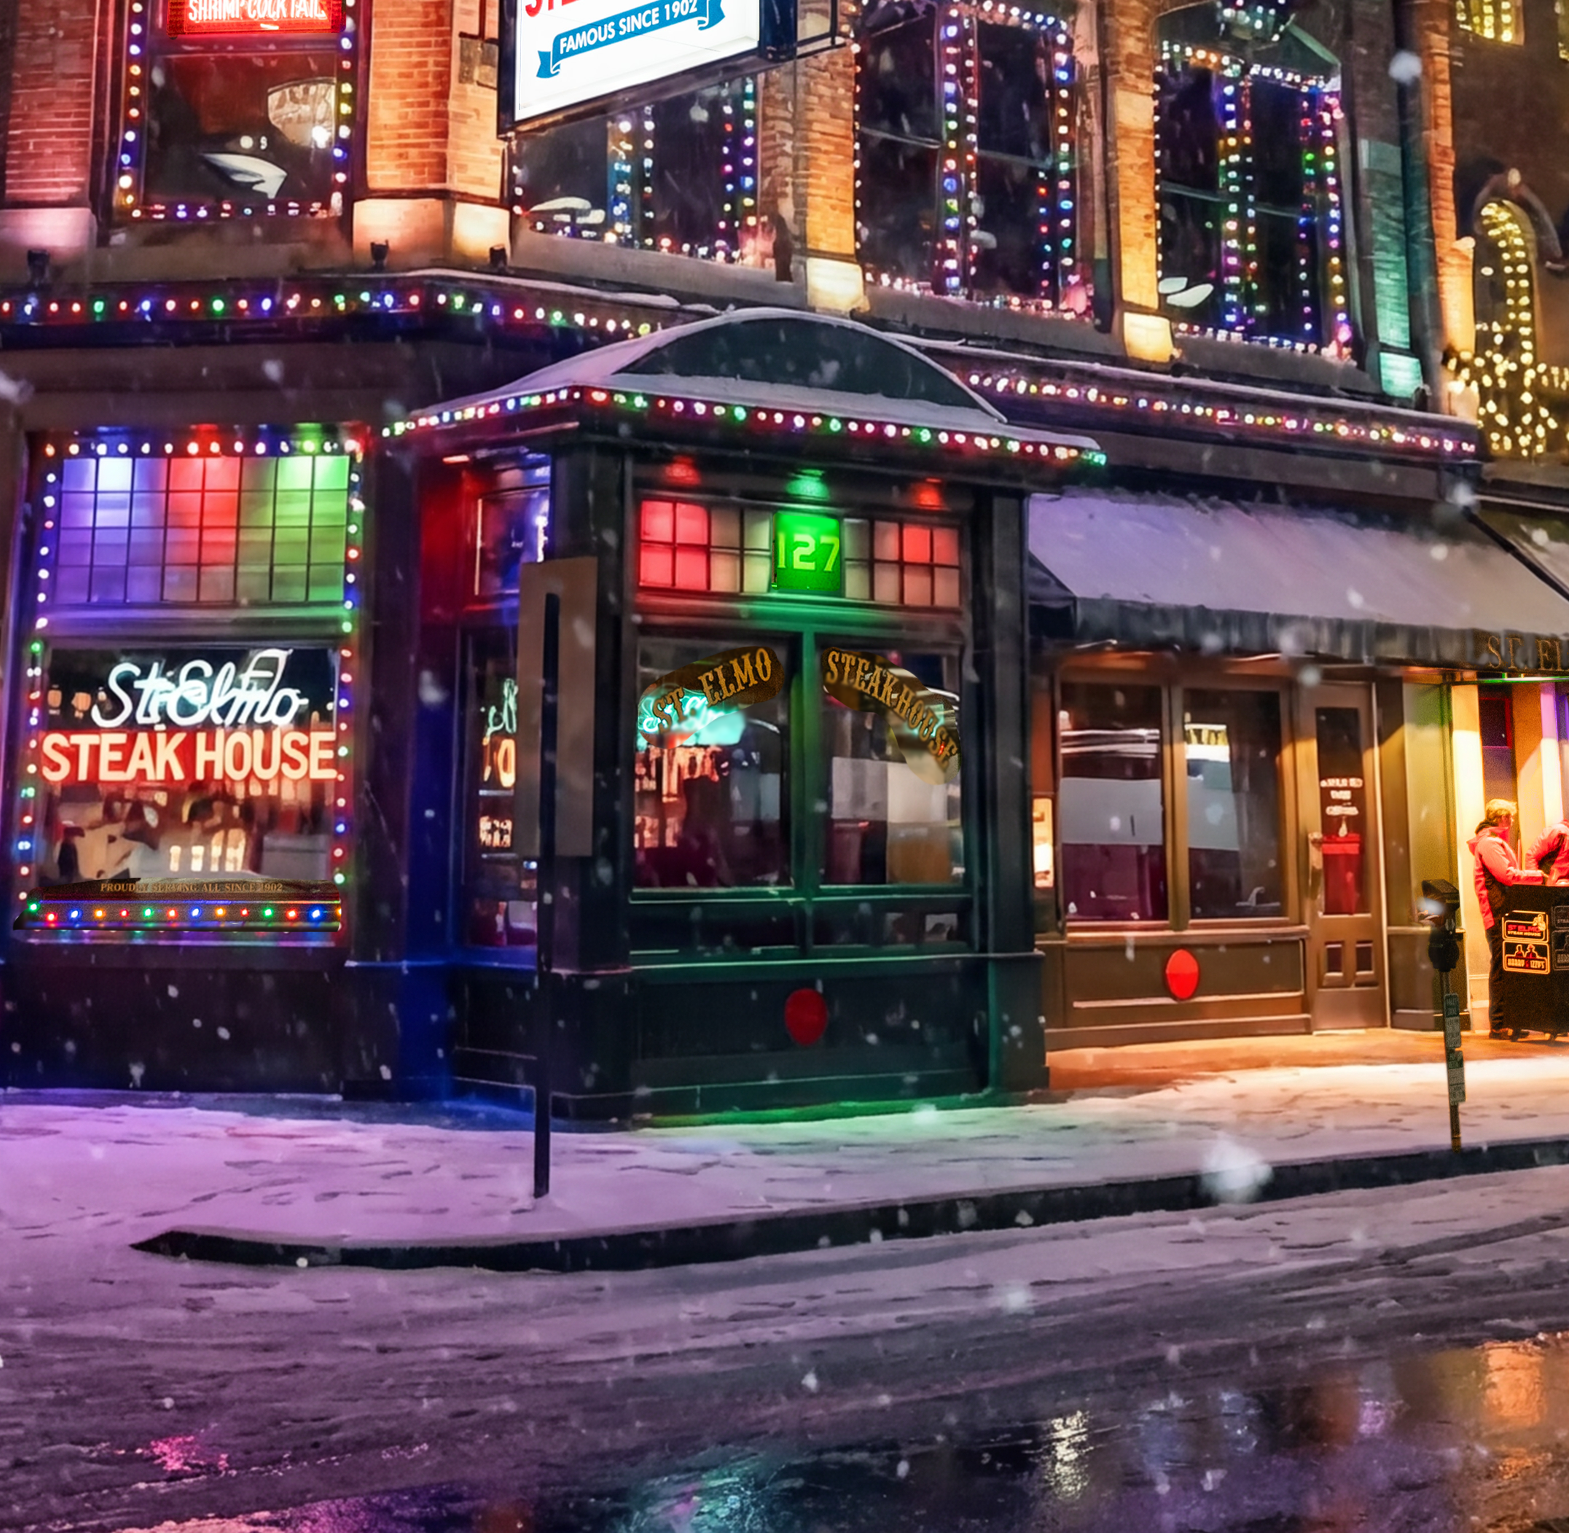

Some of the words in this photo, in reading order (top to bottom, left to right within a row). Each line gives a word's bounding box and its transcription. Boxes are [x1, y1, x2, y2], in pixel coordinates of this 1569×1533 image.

[560, 22, 615, 54] FAMOUS
[619, 7, 659, 35] SINCE
[777, 534, 840, 572] 127
[166, 656, 309, 727] Elmo
[698, 648, 772, 707] ELMO
[825, 651, 899, 707] STEAK
[894, 684, 958, 768] HOUSE
[42, 732, 186, 781] STEAK
[195, 731, 337, 781] HOUSE
[100, 883, 148, 892] PROUDLY
[153, 883, 197, 892] SERVING
[202, 883, 222, 892] ALL
[225, 883, 256, 892] SINCE
[260, 883, 283, 892] 1902
